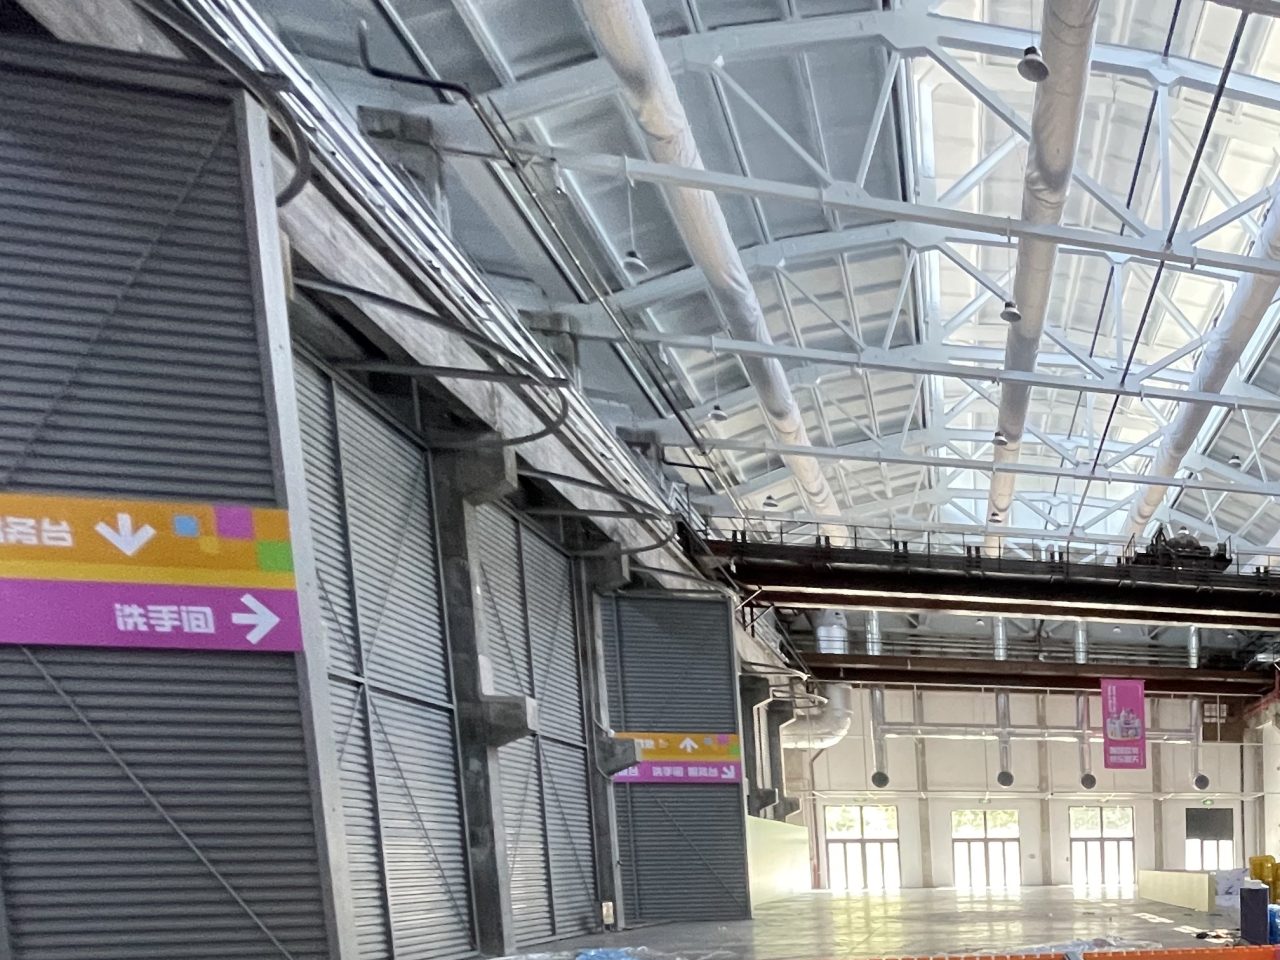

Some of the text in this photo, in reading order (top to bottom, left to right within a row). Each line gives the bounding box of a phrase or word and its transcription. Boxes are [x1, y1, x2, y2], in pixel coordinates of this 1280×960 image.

[0, 515, 73, 548] 务台
[114, 603, 216, 634] 洗手间
